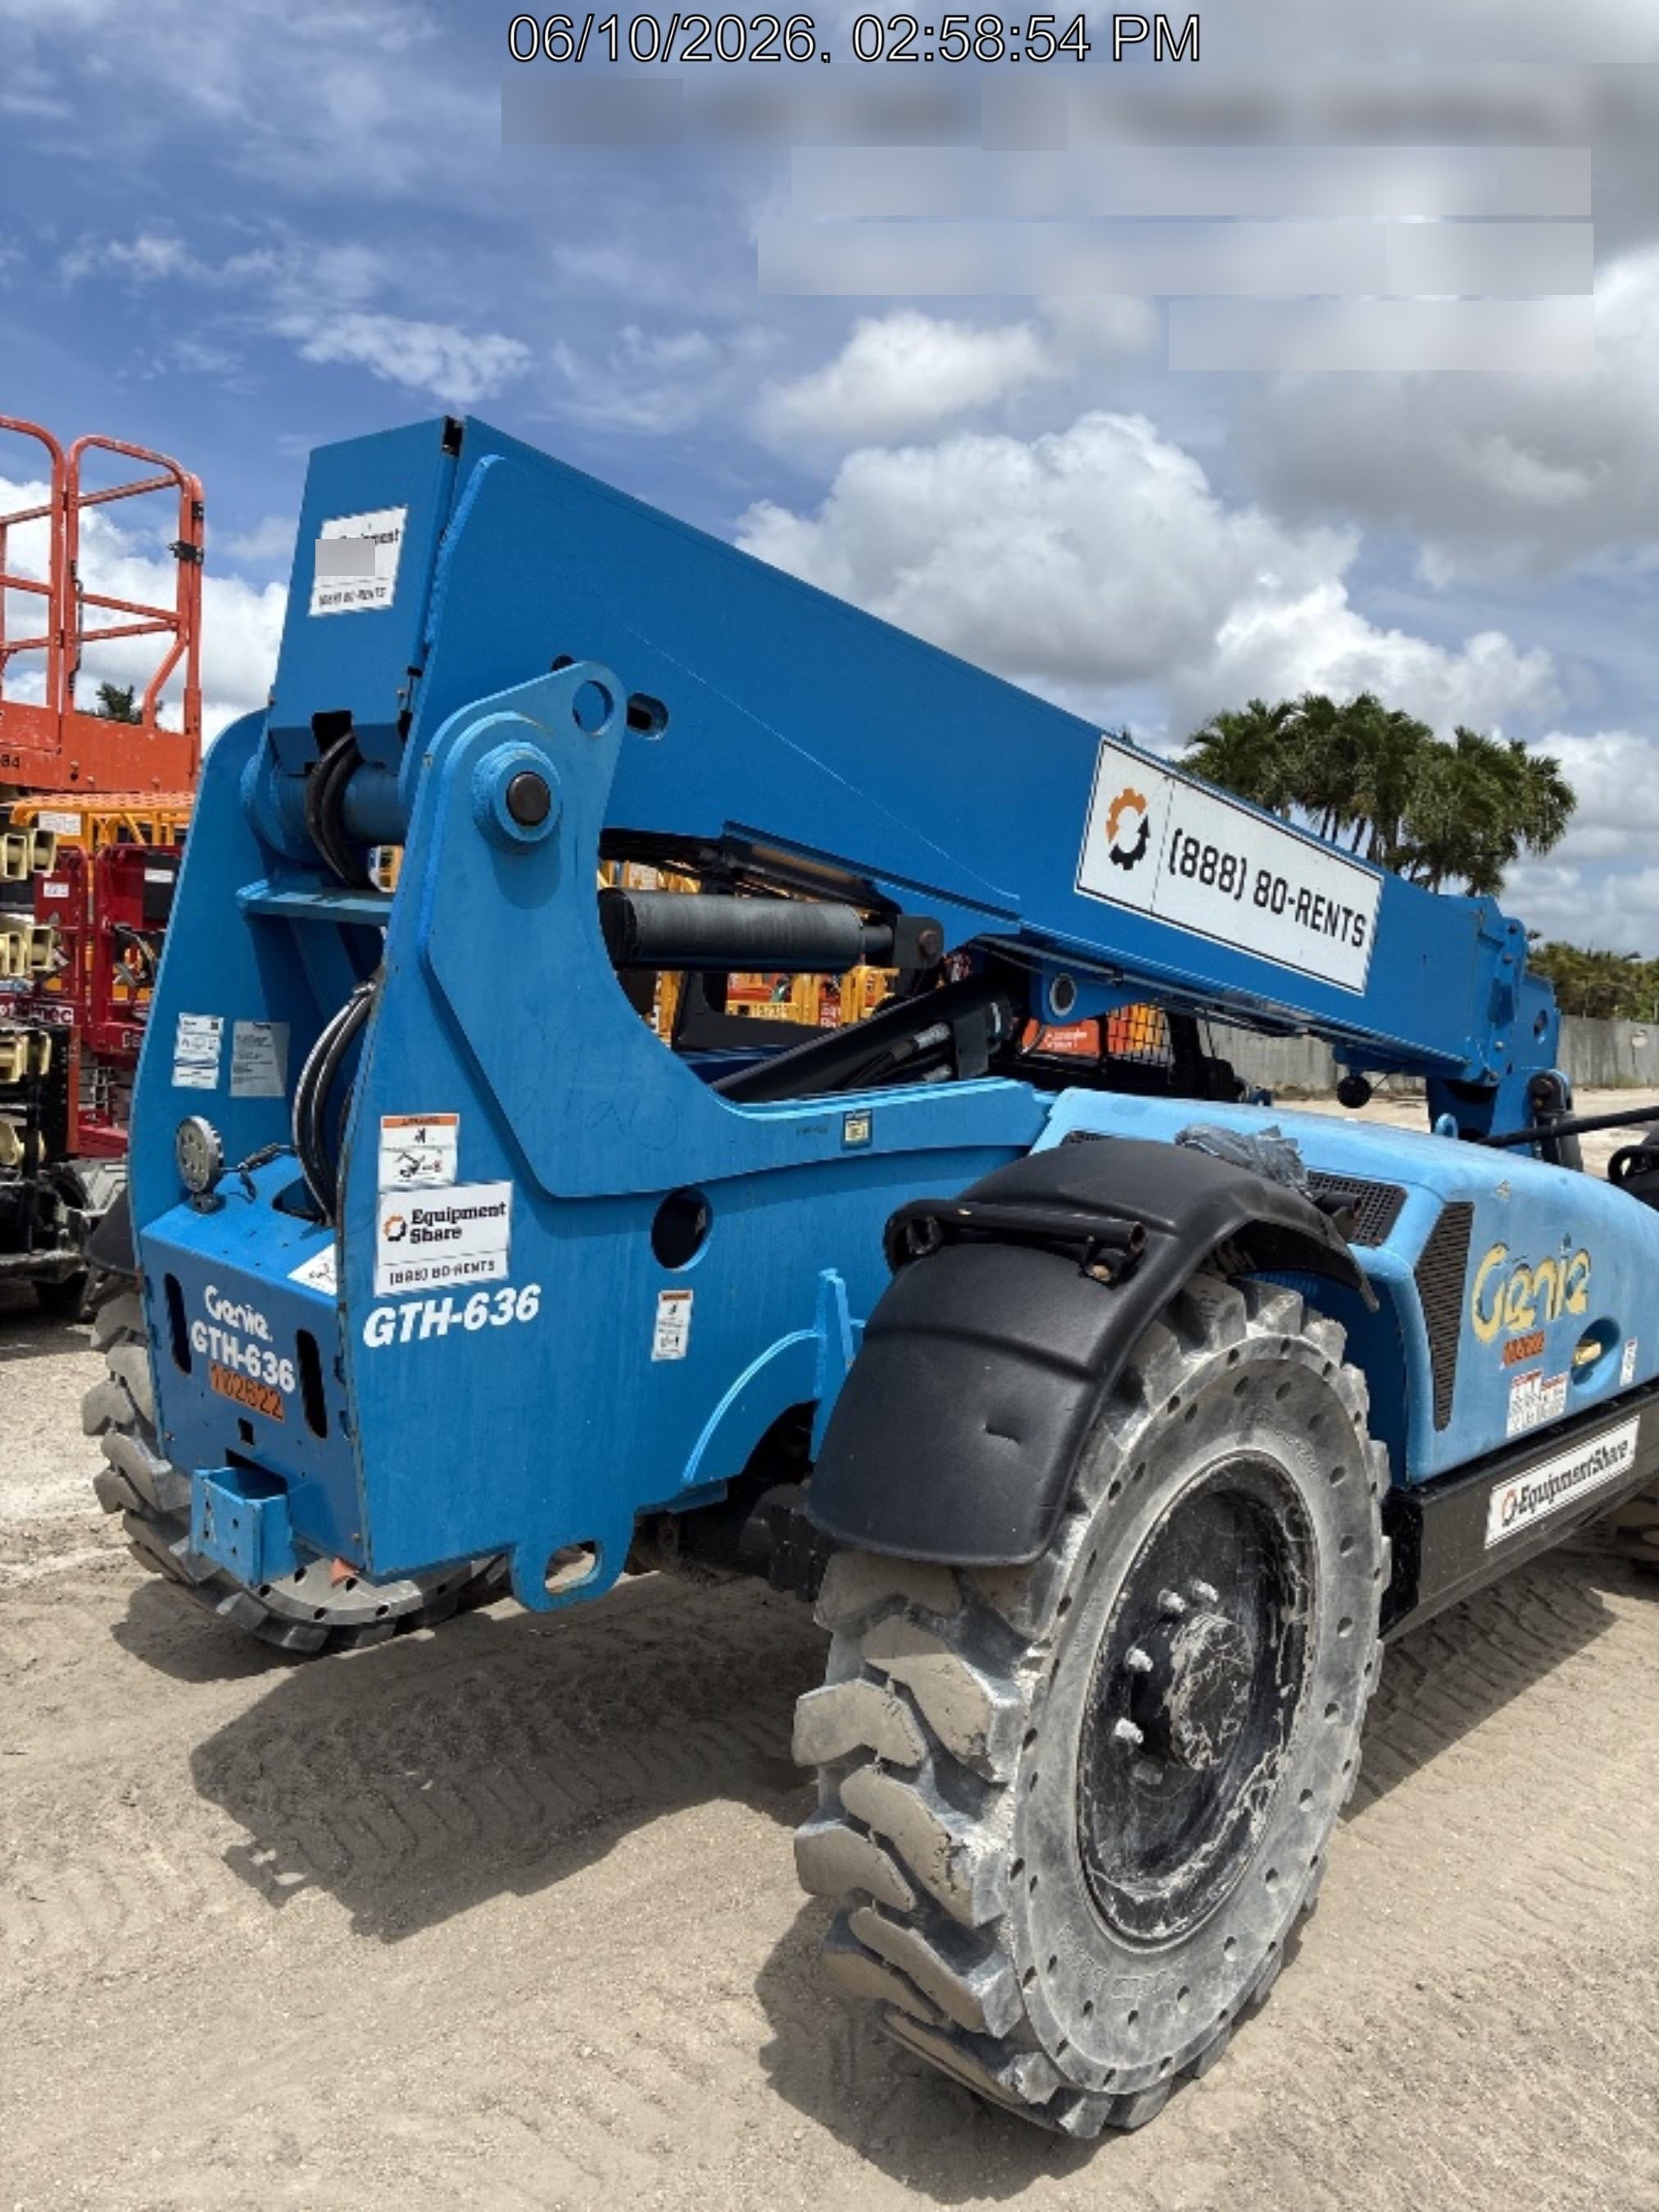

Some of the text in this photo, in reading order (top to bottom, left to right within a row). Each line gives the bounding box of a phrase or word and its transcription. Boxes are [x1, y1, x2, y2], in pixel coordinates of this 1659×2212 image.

[1167, 827, 1367, 949] (888) 80-RENTS
[410, 1226, 463, 1244] Share
[411, 1200, 507, 1226] Equipment
[205, 1284, 272, 1341] Genie
[362, 1282, 542, 1348] GTH-636
[1471, 1233, 1591, 1344] Genie
[190, 1319, 296, 1393] GTH-636
[1518, 1439, 1629, 1512] EquipmentShare
